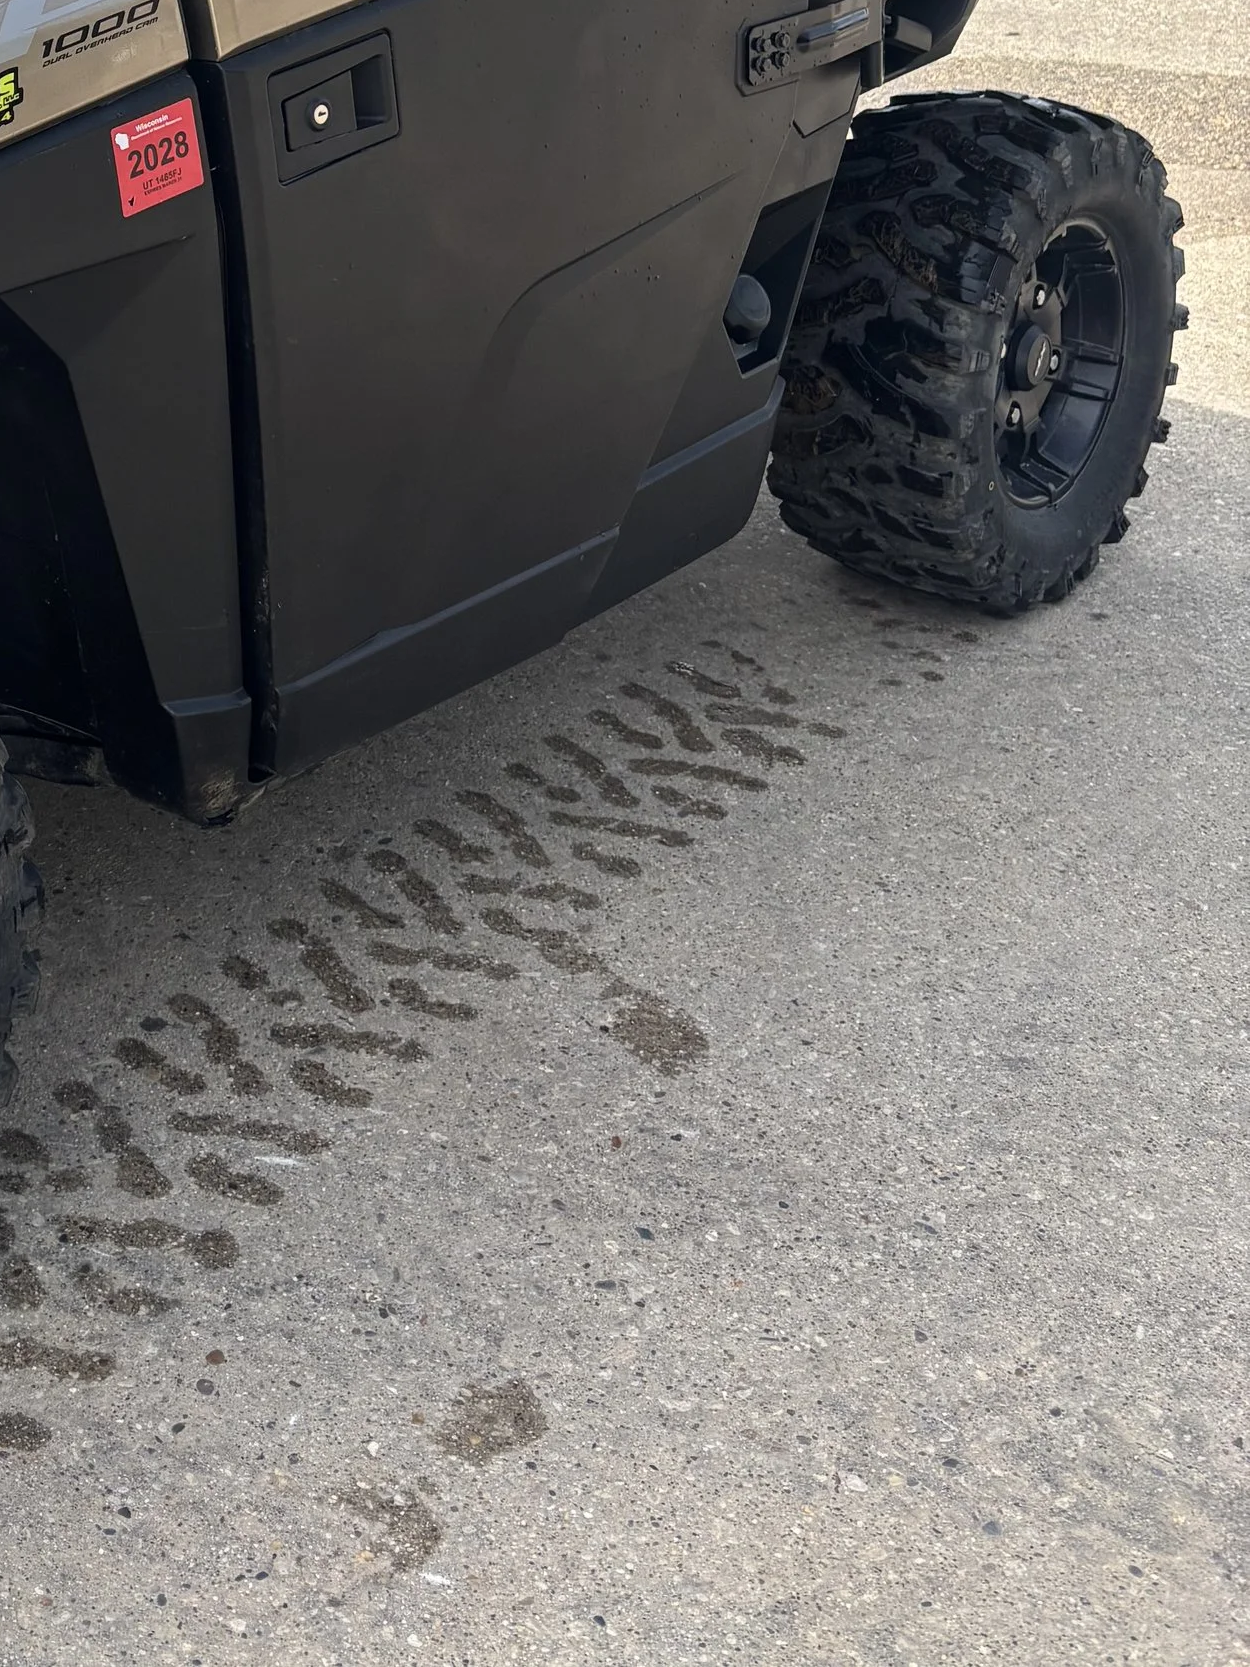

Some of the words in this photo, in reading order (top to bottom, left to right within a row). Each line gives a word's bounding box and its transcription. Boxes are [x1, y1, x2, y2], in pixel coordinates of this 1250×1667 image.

[42, 54, 73, 68] DUAL
[75, 27, 134, 55] OVERHEAD
[135, 17, 159, 30] CAM
[3, 93, 20, 105] LLC
[135, 114, 169, 133] Wisconsin
[127, 131, 190, 180] 2028
[142, 179, 154, 191] UT
